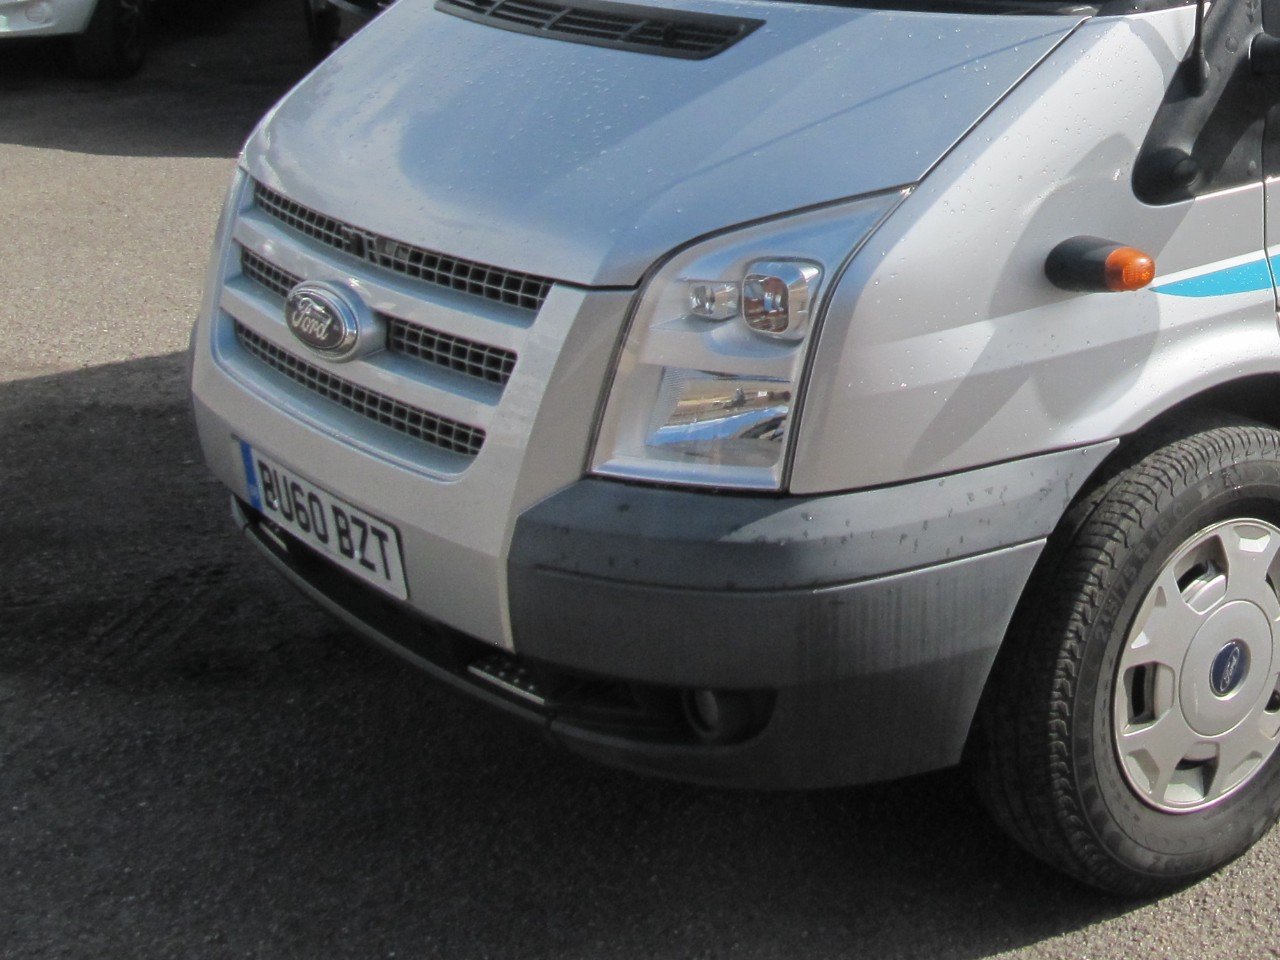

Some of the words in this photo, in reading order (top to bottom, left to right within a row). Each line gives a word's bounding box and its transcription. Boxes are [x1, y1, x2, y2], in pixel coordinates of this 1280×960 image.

[292, 296, 334, 340] Ford
[257, 459, 329, 544] BU60
[331, 504, 392, 581] BZT
